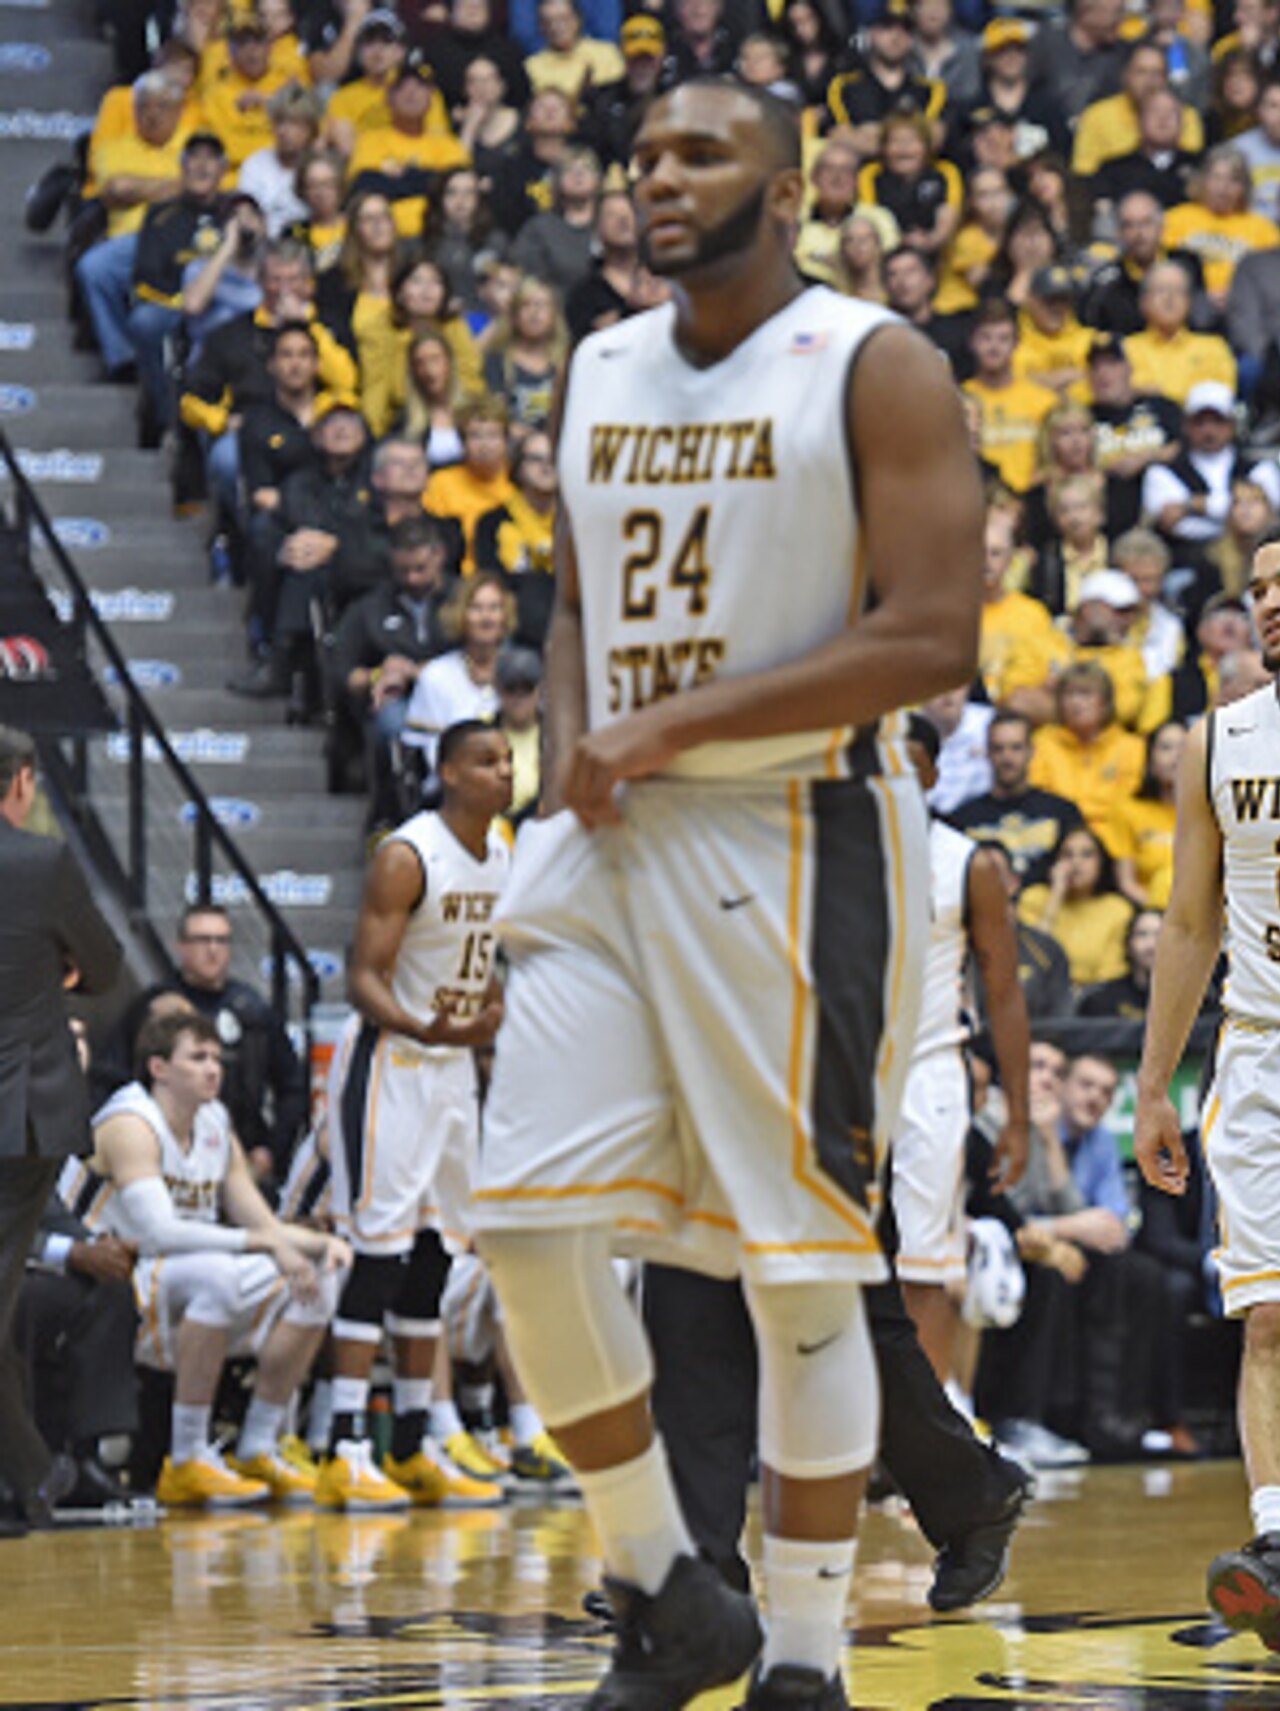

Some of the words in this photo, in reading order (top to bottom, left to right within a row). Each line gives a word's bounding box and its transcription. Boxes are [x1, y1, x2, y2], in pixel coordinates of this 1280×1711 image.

[588, 417, 777, 485] WICHITA
[622, 503, 713, 621] 24
[457, 930, 492, 979] 15
